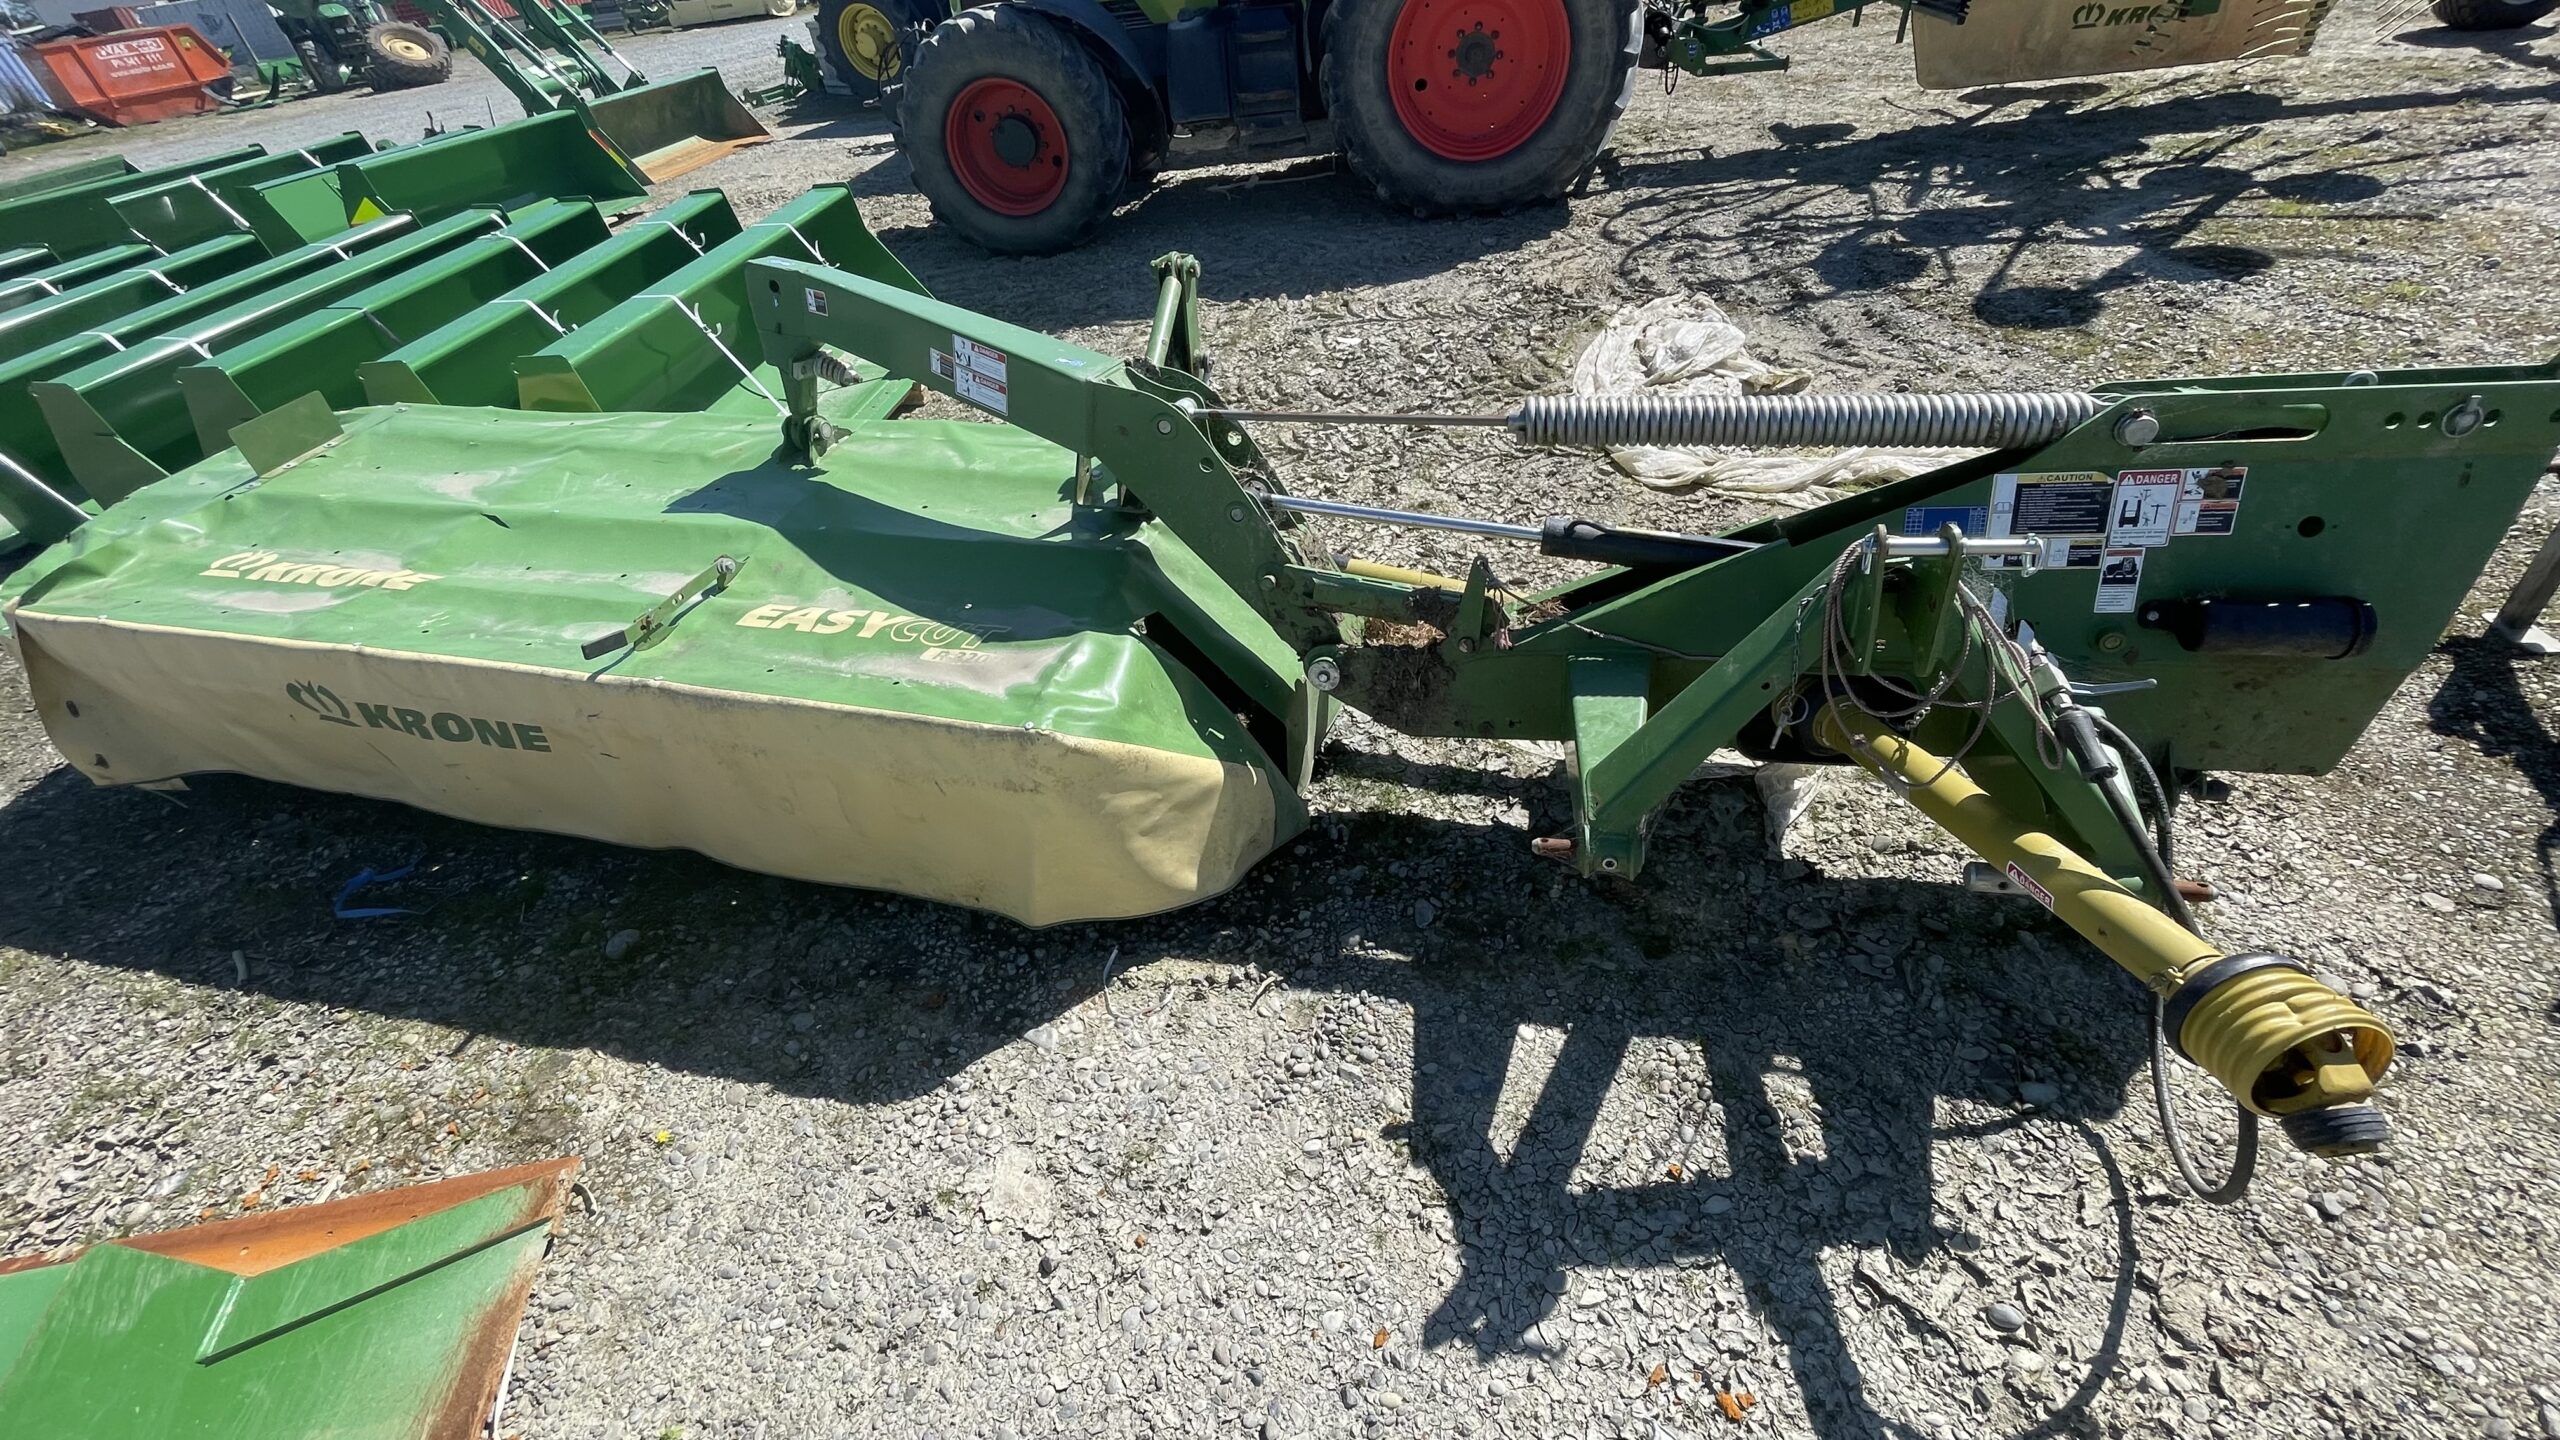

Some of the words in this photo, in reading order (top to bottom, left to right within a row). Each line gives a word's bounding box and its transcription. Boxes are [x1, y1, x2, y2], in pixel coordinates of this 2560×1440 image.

[2046, 473, 2094, 483] CAUTION
[2135, 473, 2178, 485] DANGER
[244, 561, 446, 591] KRONE
[354, 701, 553, 753] KRONE
[2019, 875, 2051, 906] DANGER
